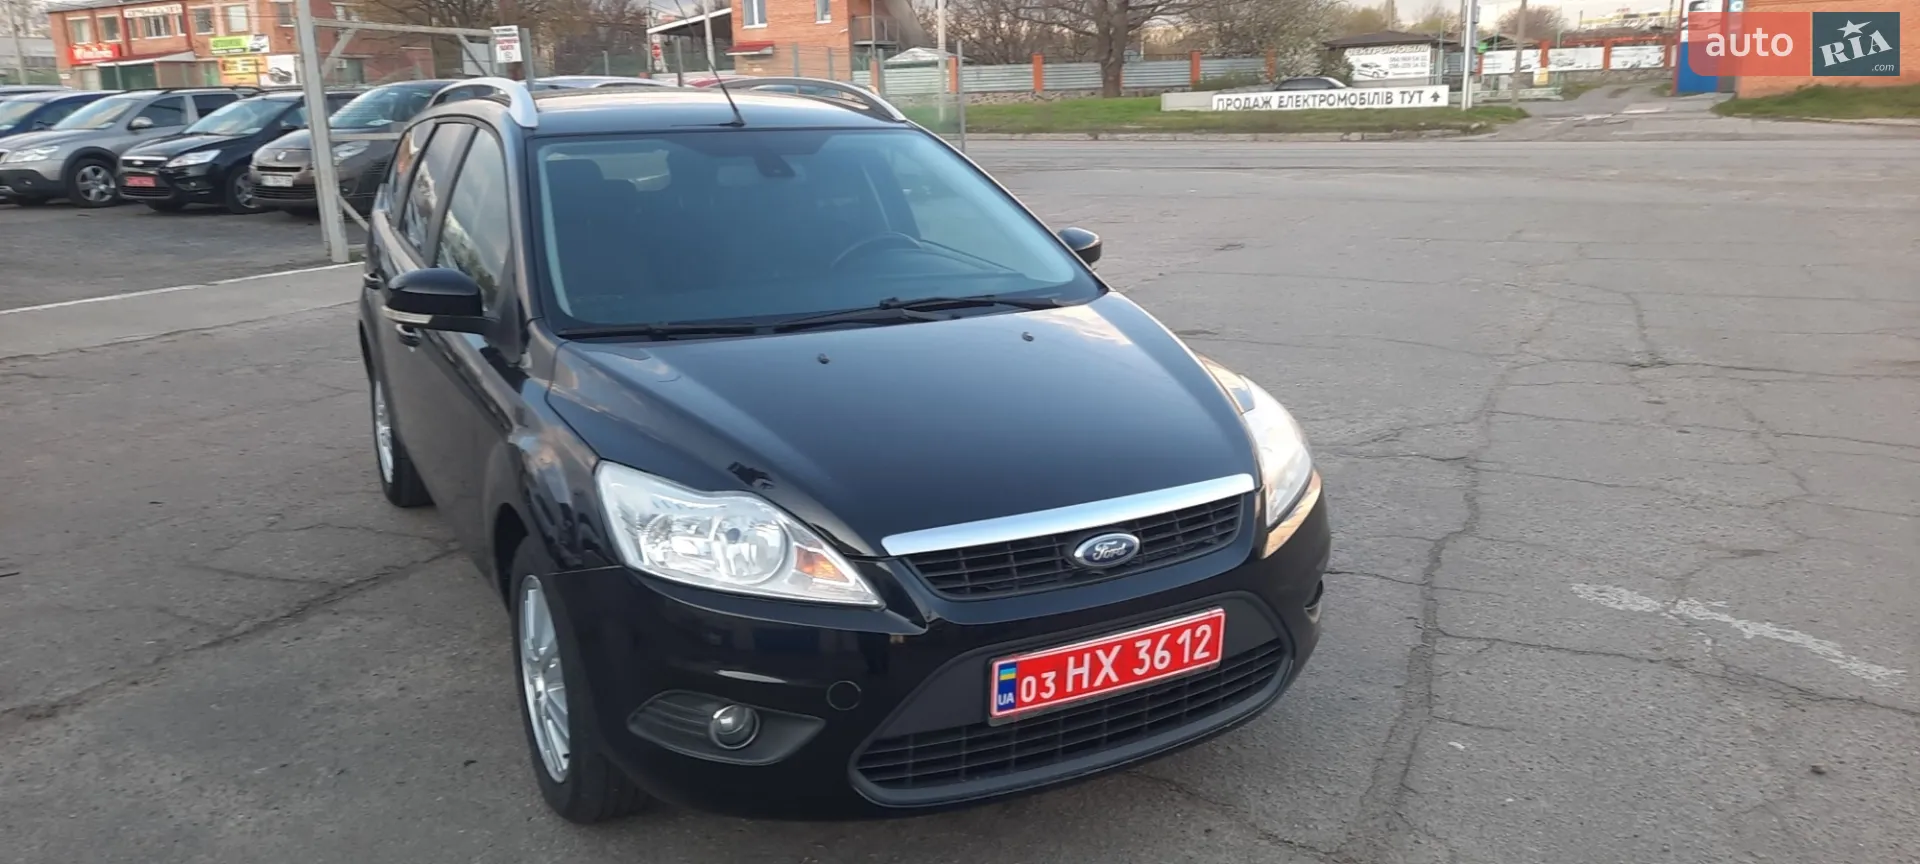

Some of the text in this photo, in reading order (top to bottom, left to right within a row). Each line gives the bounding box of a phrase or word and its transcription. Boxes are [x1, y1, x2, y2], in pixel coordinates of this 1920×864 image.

[1217, 90, 1424, 111] ПРОДАЖ ЕЛЕКТРОМОБІЛІВ ТУТ
[1092, 540, 1127, 561] Ford
[1020, 624, 1212, 703] 03 HX 3612
[997, 693, 1015, 706] UA
